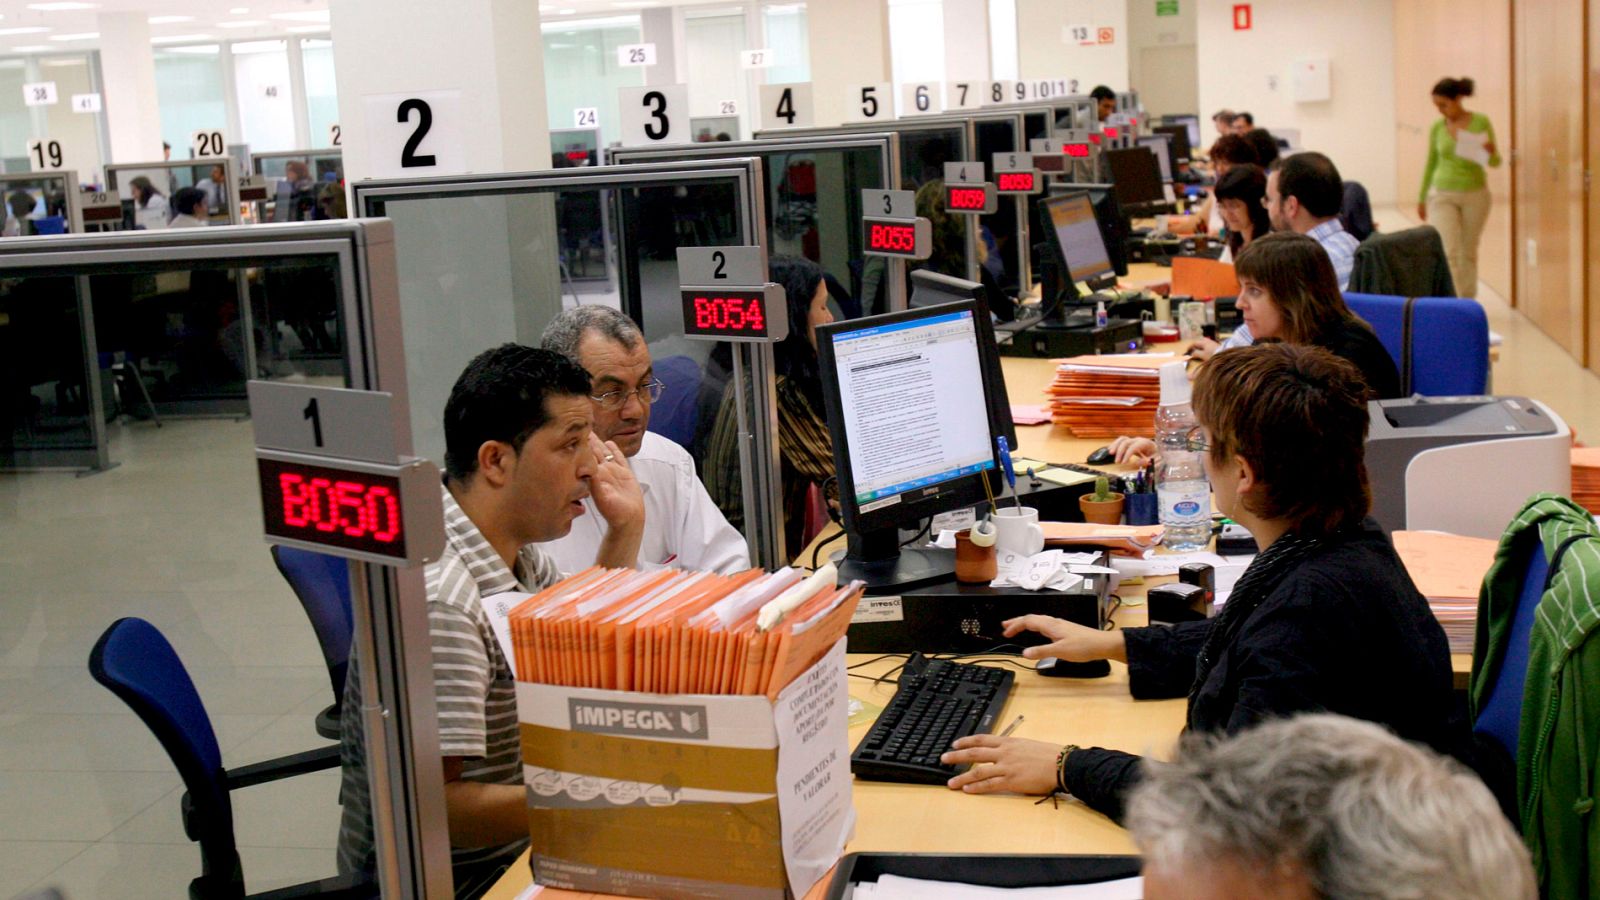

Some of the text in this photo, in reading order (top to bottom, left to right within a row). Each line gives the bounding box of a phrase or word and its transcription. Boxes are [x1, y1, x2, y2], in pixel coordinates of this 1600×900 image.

[1072, 27, 1088, 40] 13
[630, 48, 646, 63] 25
[751, 53, 763, 65] 27
[33, 87, 48, 101] 38
[265, 86, 277, 97] 40
[916, 85, 929, 111] 6
[956, 84, 968, 106] 7
[992, 82, 1003, 102] 8
[1016, 82, 1026, 100] 9
[82, 98, 92, 109] 41
[722, 102, 735, 114] 26
[776, 88, 796, 124] 4
[861, 86, 878, 117] 5
[578, 110, 596, 126] 24
[642, 91, 670, 140] 3
[397, 98, 436, 168] 2
[197, 131, 224, 156] 20
[1044, 142, 1051, 152] 6
[32, 140, 63, 169] 19
[1009, 155, 1016, 168] 5
[960, 167, 967, 181] 4
[91, 192, 107, 204] 20
[883, 194, 893, 214] 3
[950, 189, 985, 208] B059
[871, 224, 915, 250] B055
[712, 250, 728, 279] 2
[693, 297, 764, 329] B054
[303, 398, 323, 447] 1
[279, 472, 399, 542] B050
